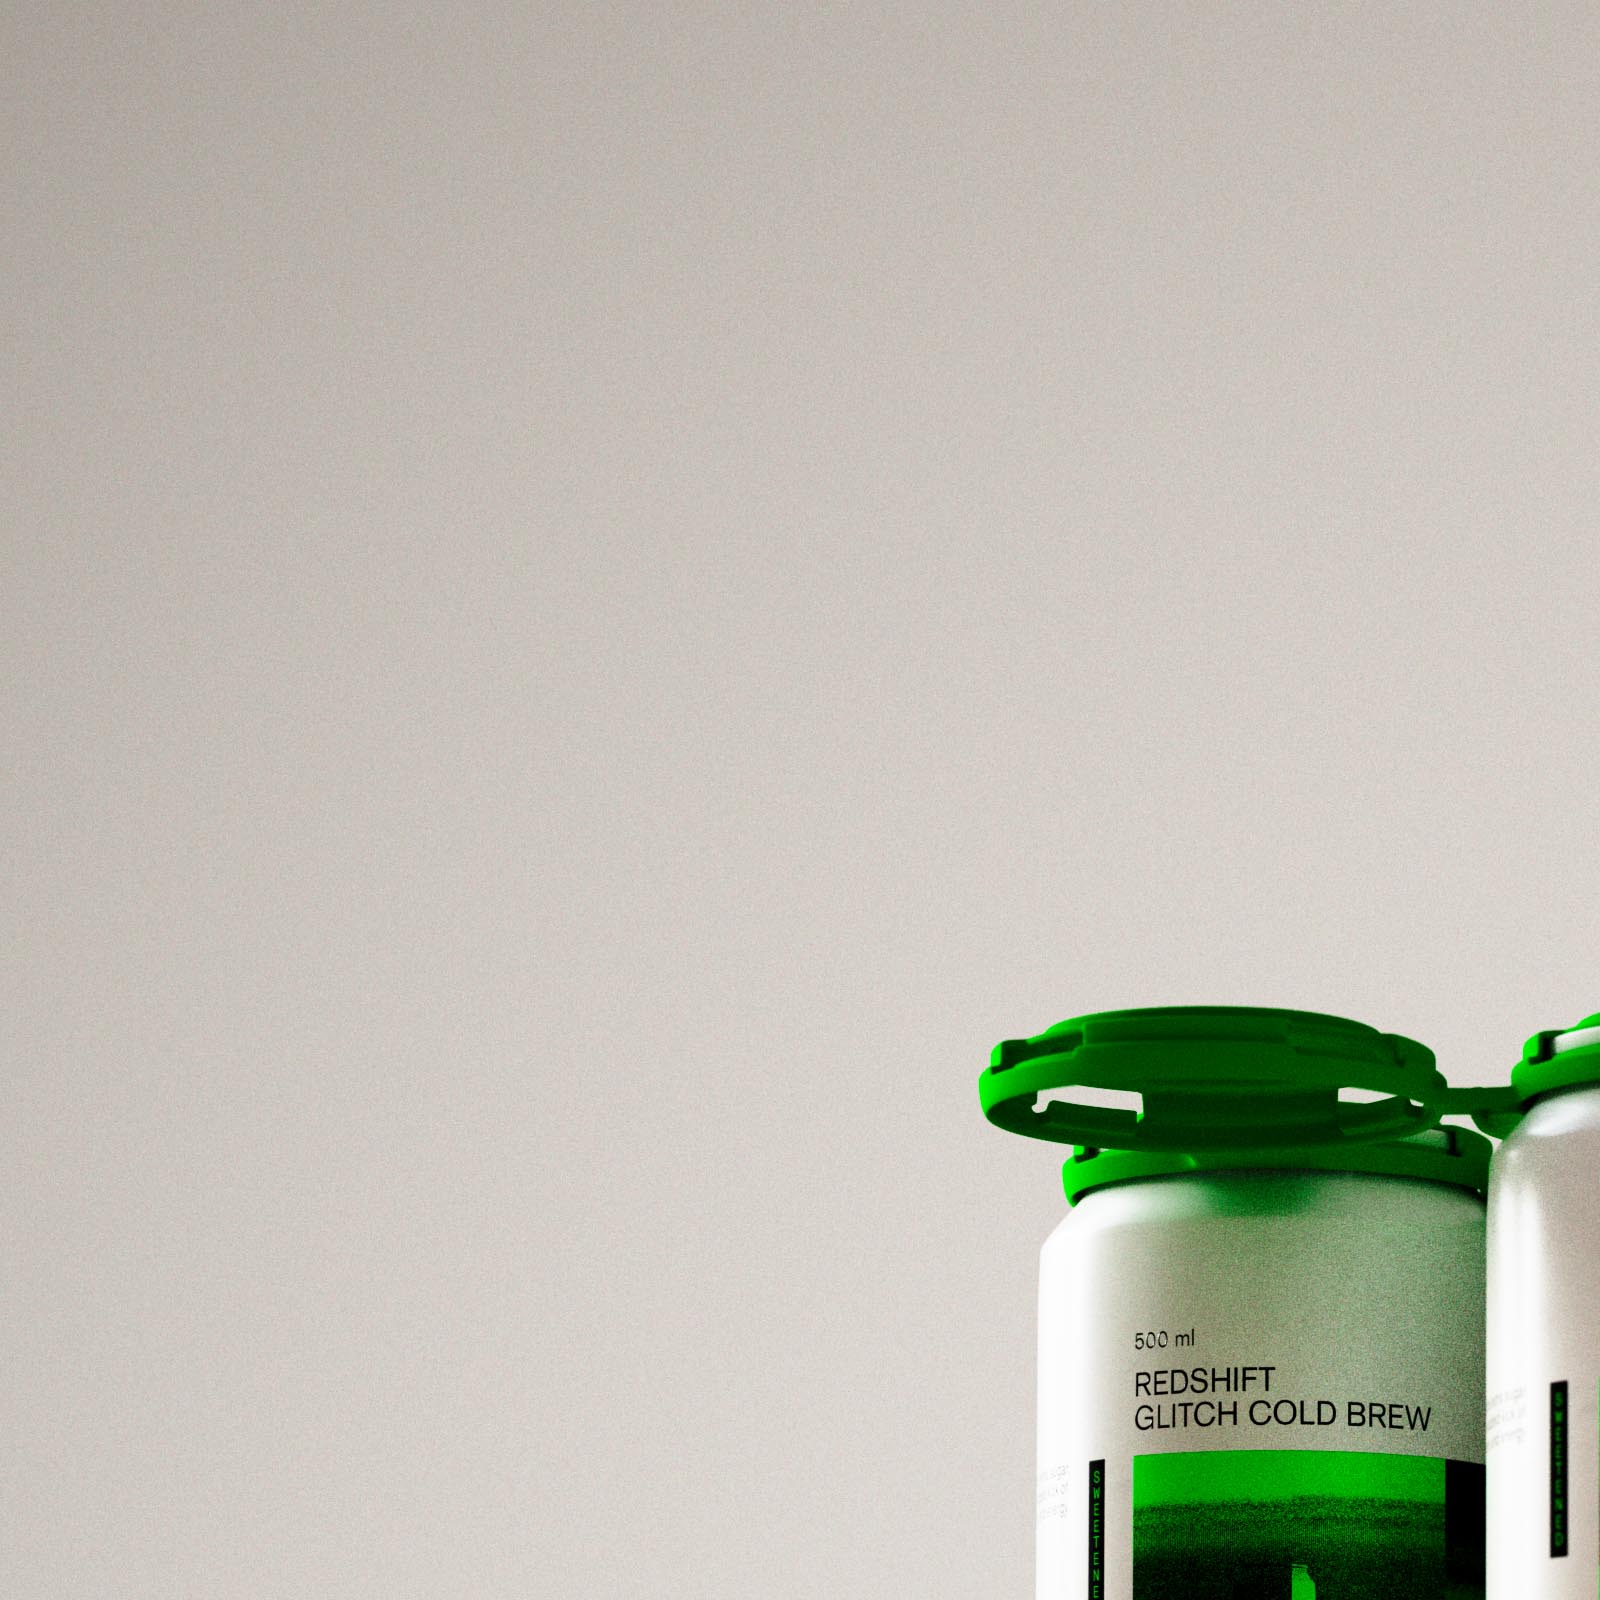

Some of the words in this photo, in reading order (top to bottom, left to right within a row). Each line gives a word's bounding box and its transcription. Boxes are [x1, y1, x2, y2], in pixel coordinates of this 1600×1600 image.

[1134, 1331, 1169, 1350] 500
[1174, 1328, 1196, 1347] ml
[1134, 1366, 1277, 1398] REDSHIFT
[1134, 1400, 1239, 1431] GLITCH
[1248, 1399, 1338, 1427] COLD
[1346, 1400, 1432, 1432] BREW
